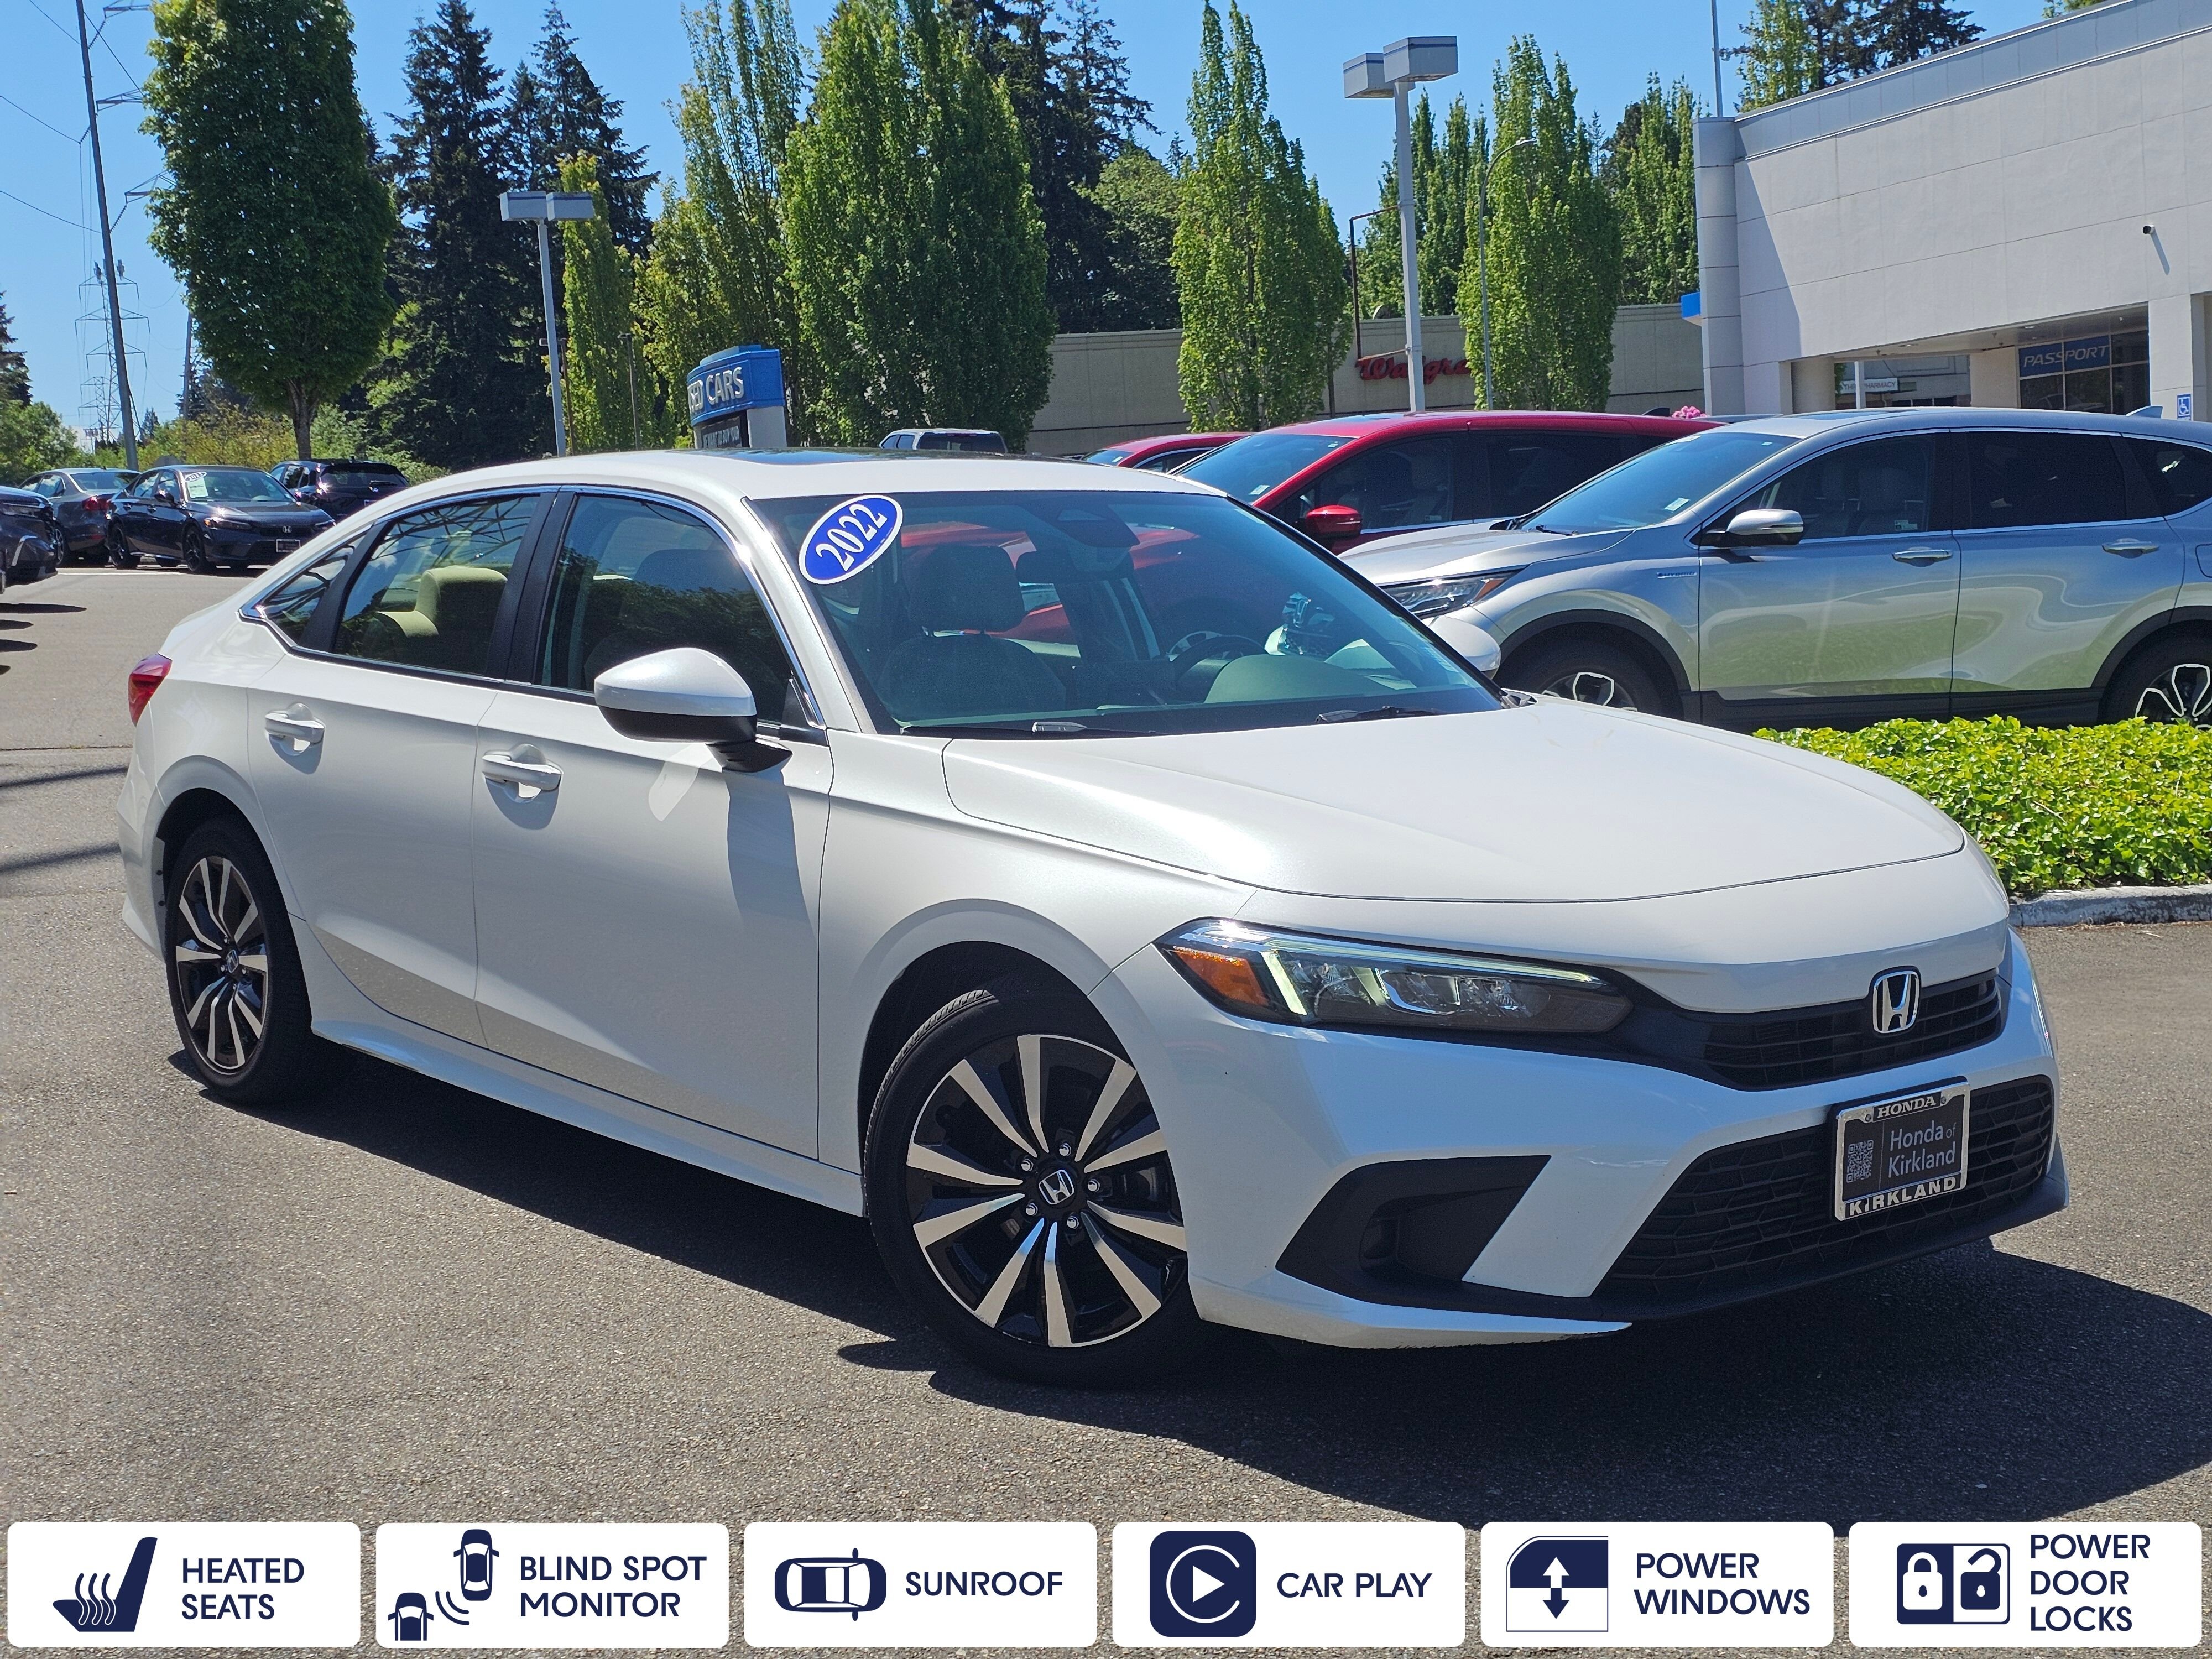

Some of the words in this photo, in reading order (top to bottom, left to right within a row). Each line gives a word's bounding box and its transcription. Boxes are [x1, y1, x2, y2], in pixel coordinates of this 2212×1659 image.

[2023, 345, 2110, 368] PASSPORT
[706, 366, 744, 405] CARS
[815, 503, 888, 572] 2022
[1876, 1095, 1937, 1119] HONDA
[1890, 1120, 1943, 1151] Honda
[1945, 1122, 1957, 1139] of
[1888, 1141, 1956, 1178] Kirkland
[1849, 1176, 1957, 1216] KIRKLAND
